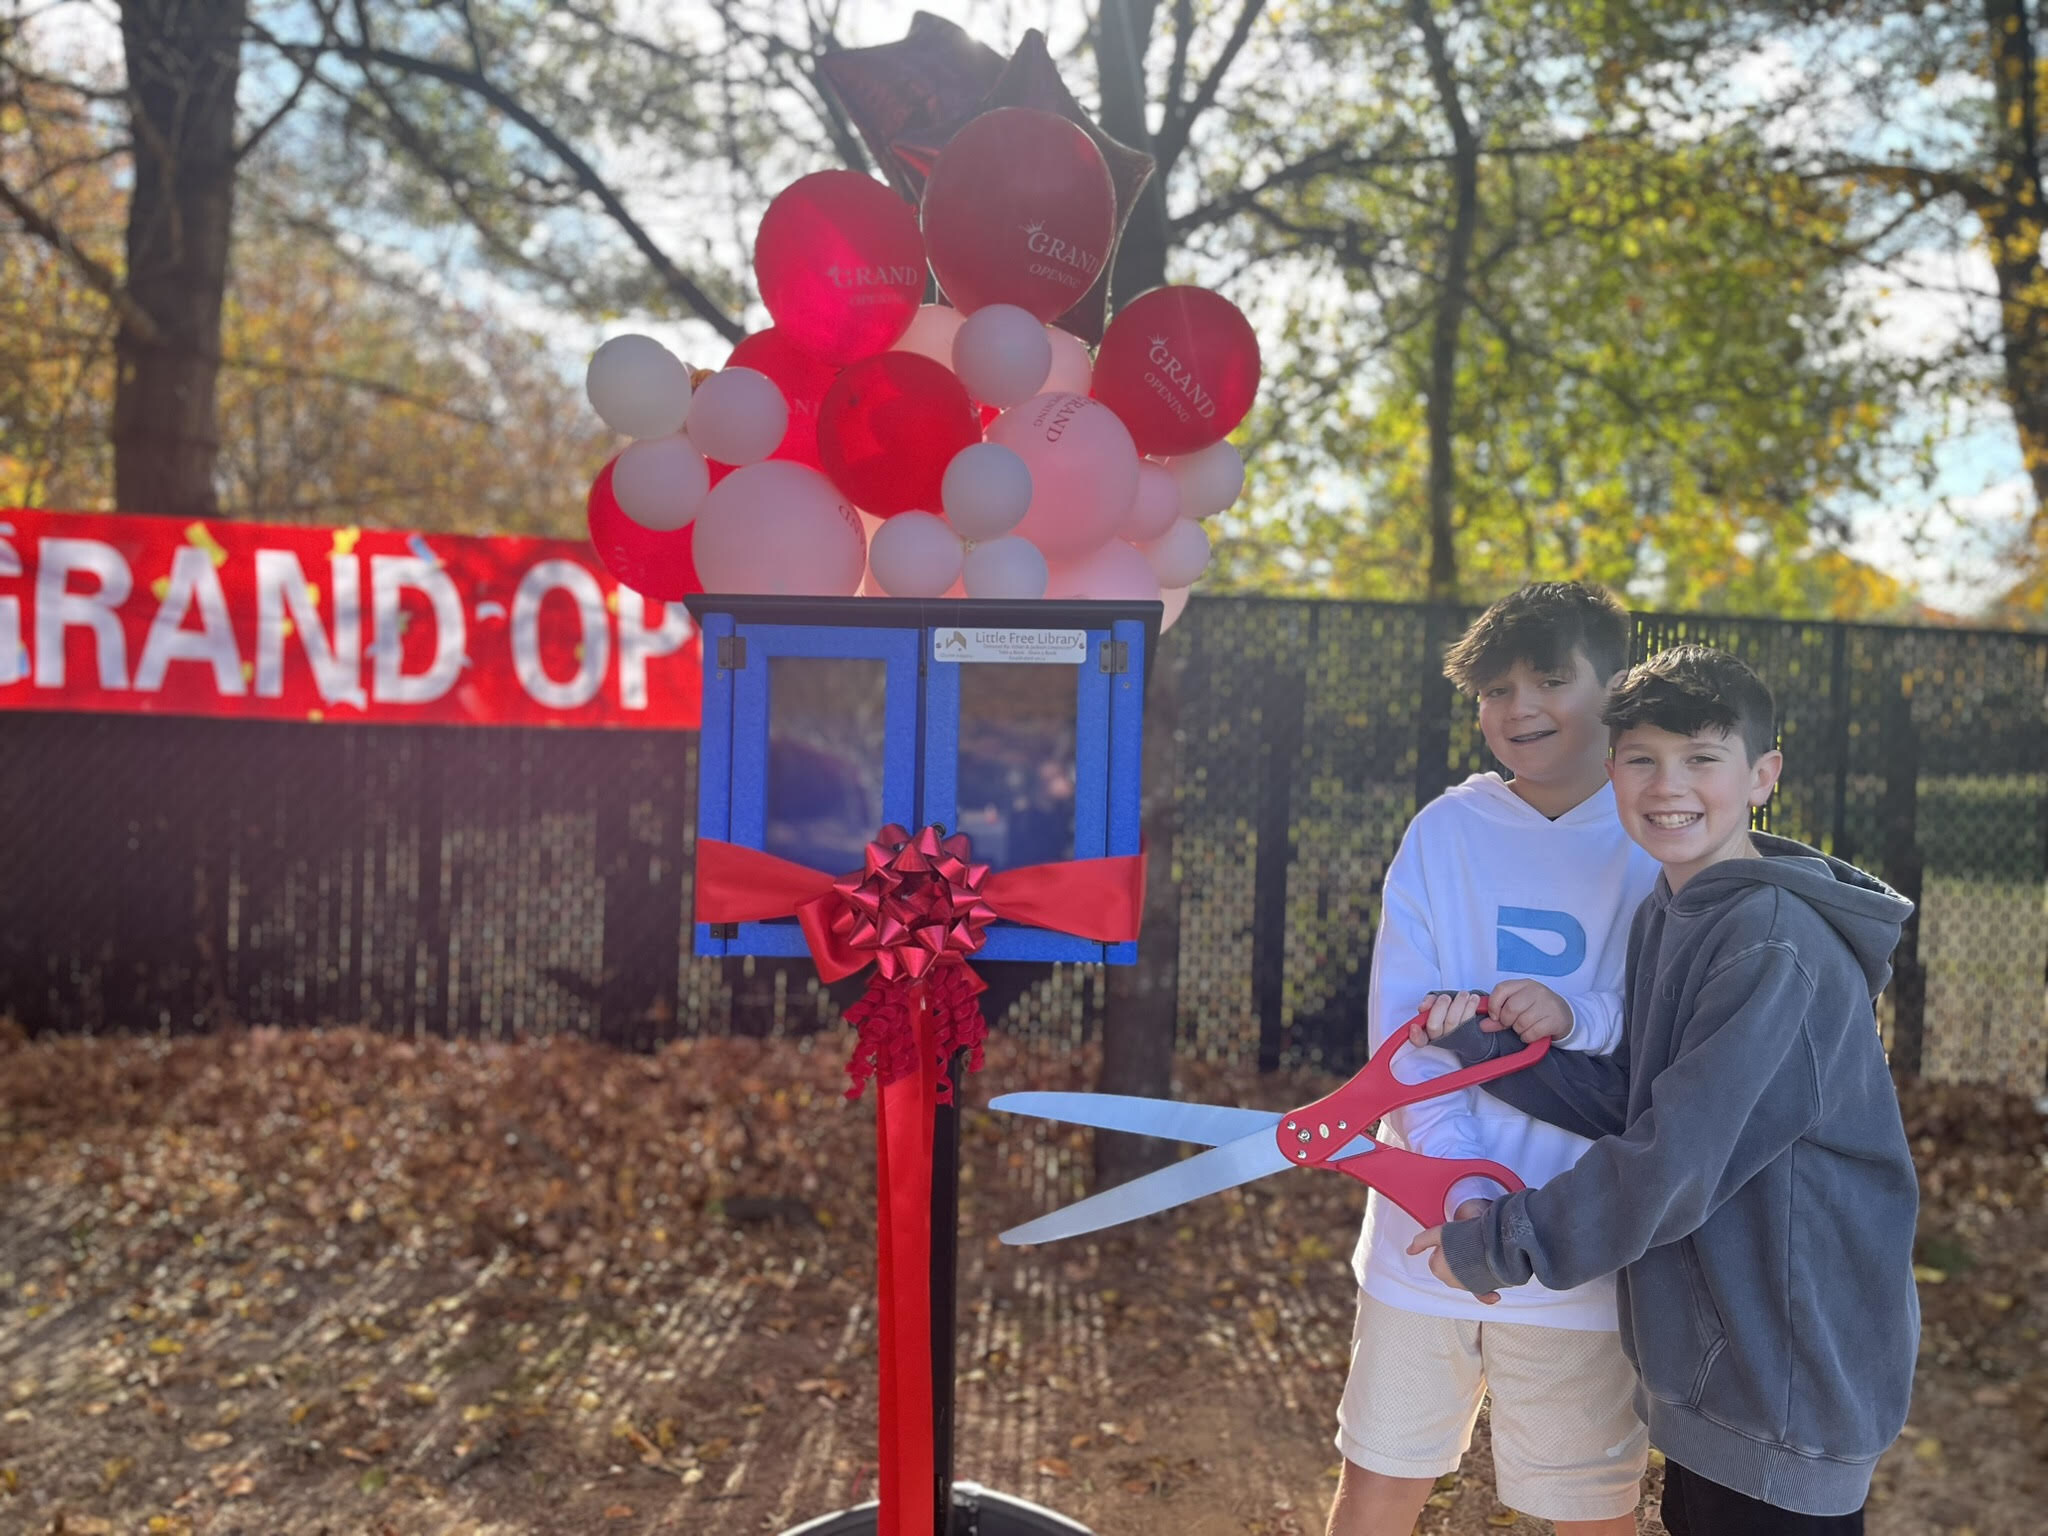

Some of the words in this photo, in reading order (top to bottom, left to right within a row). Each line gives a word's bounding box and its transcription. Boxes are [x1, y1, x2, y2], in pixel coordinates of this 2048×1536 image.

[834, 265, 918, 288] GRAND
[1028, 232, 1100, 274] GRAND
[1144, 371, 1191, 423] OPENING
[1148, 344, 1217, 419] GRAND
[0, 538, 467, 705] RAND
[975, 631, 1006, 644] Little
[1009, 632, 1034, 645] Free
[1038, 632, 1080, 648] Library
